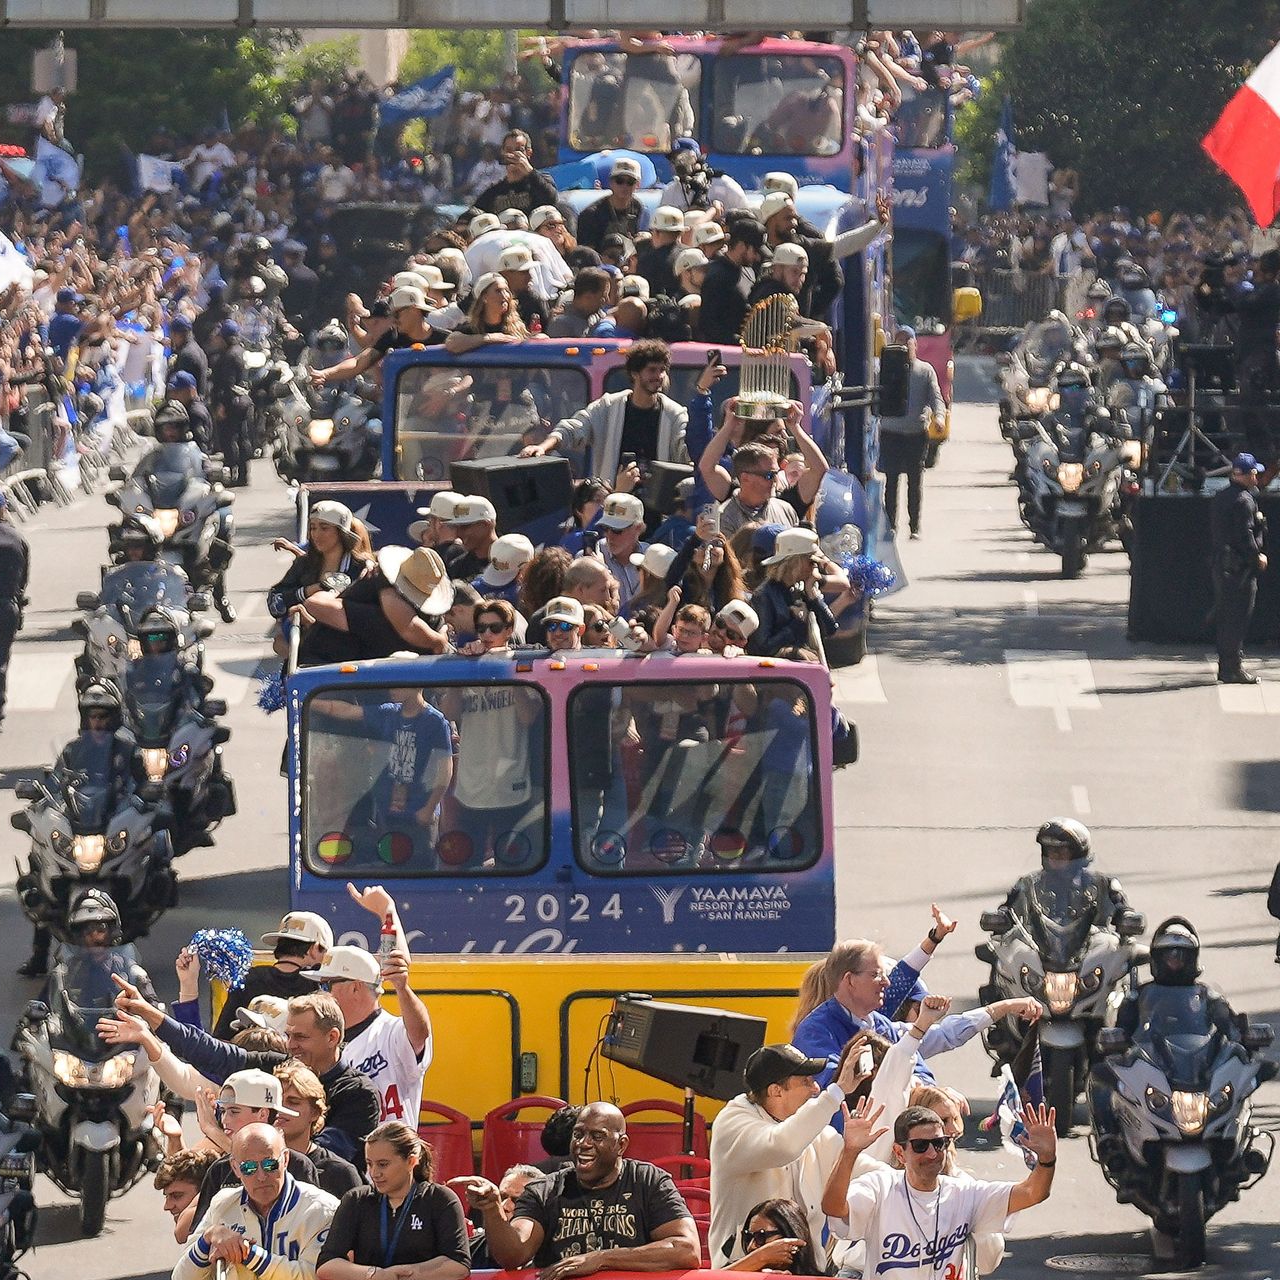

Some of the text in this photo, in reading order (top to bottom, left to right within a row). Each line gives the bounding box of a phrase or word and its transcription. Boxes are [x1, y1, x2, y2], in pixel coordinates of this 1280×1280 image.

[504, 893, 624, 922] 2024
[689, 899, 791, 912] RESORT & CASINO
[708, 911, 732, 921] SAN
[734, 909, 782, 921] MANUEL
[411, 1214, 423, 1230] LA
[880, 1222, 969, 1272] Dodgers
